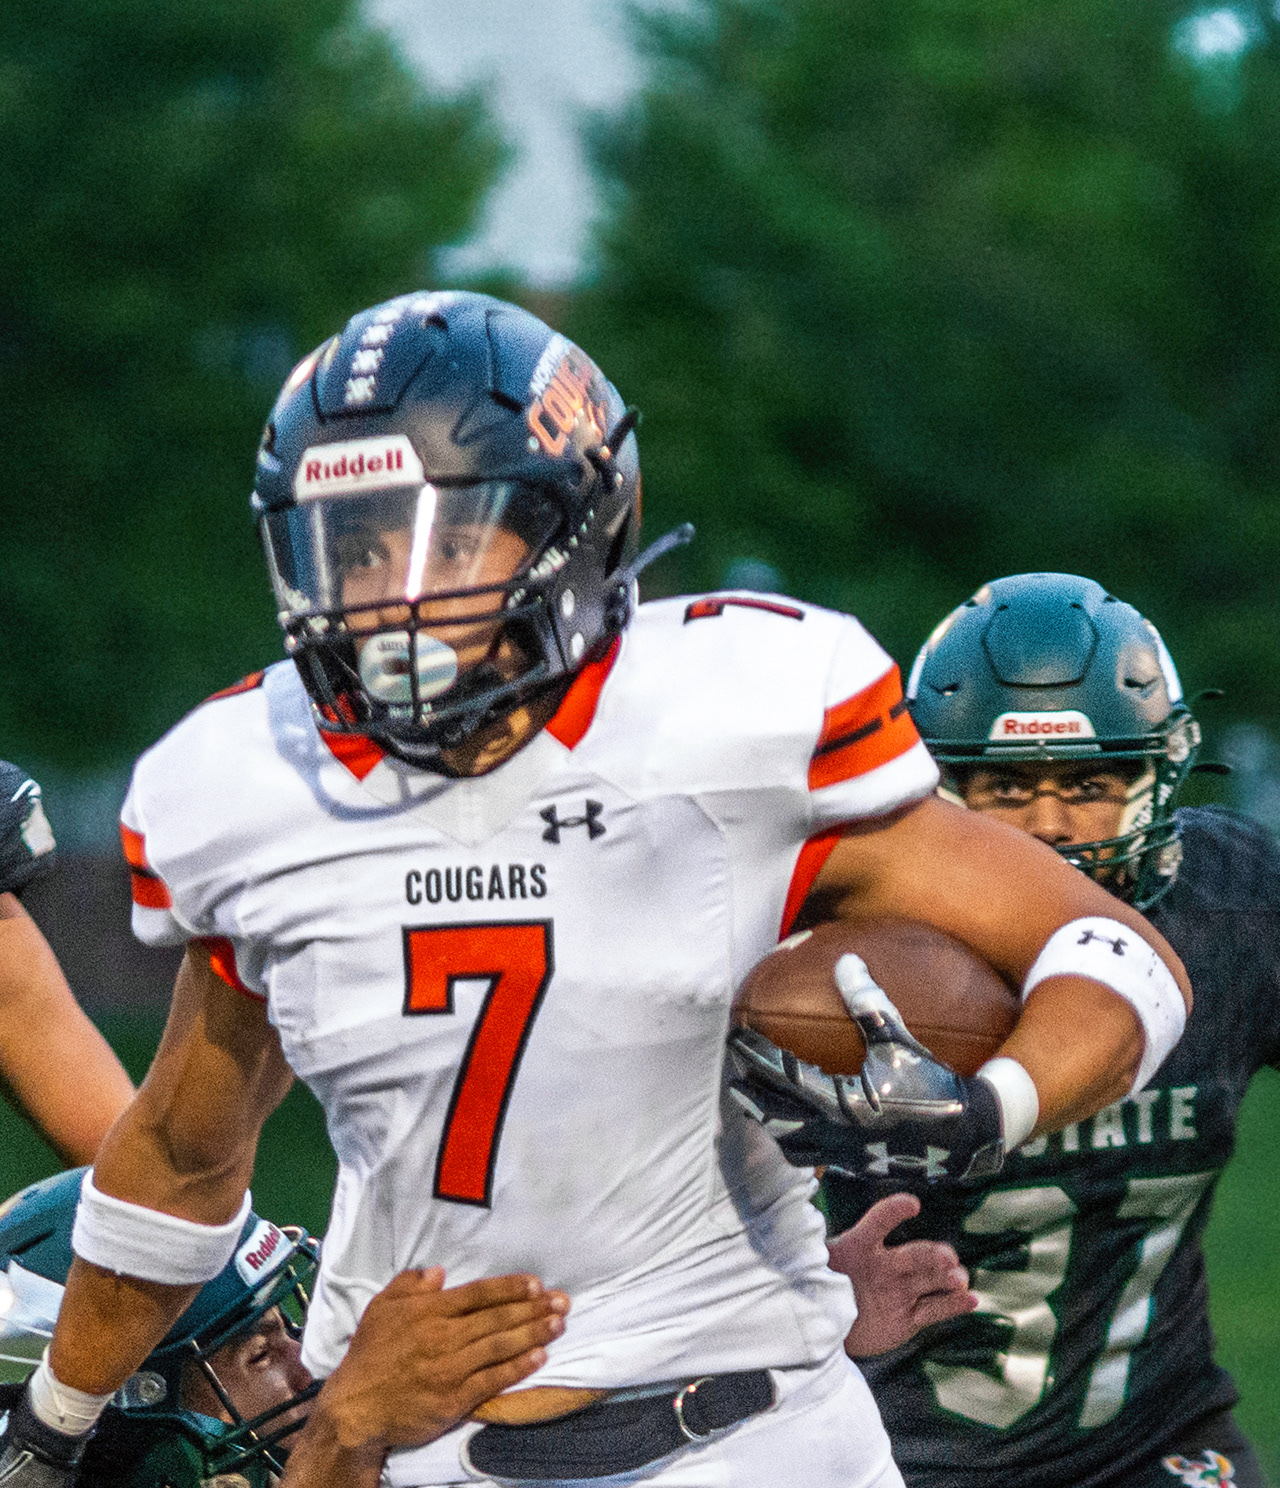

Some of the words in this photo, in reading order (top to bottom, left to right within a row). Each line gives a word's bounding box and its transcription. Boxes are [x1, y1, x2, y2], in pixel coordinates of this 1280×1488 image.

[305, 447, 403, 483] Riddell
[1003, 718, 1080, 735] Riddell
[405, 863, 549, 906] COUGARS
[401, 917, 556, 1210] 7
[1019, 1085, 1198, 1158] ATE
[922, 1171, 1218, 1430] 37
